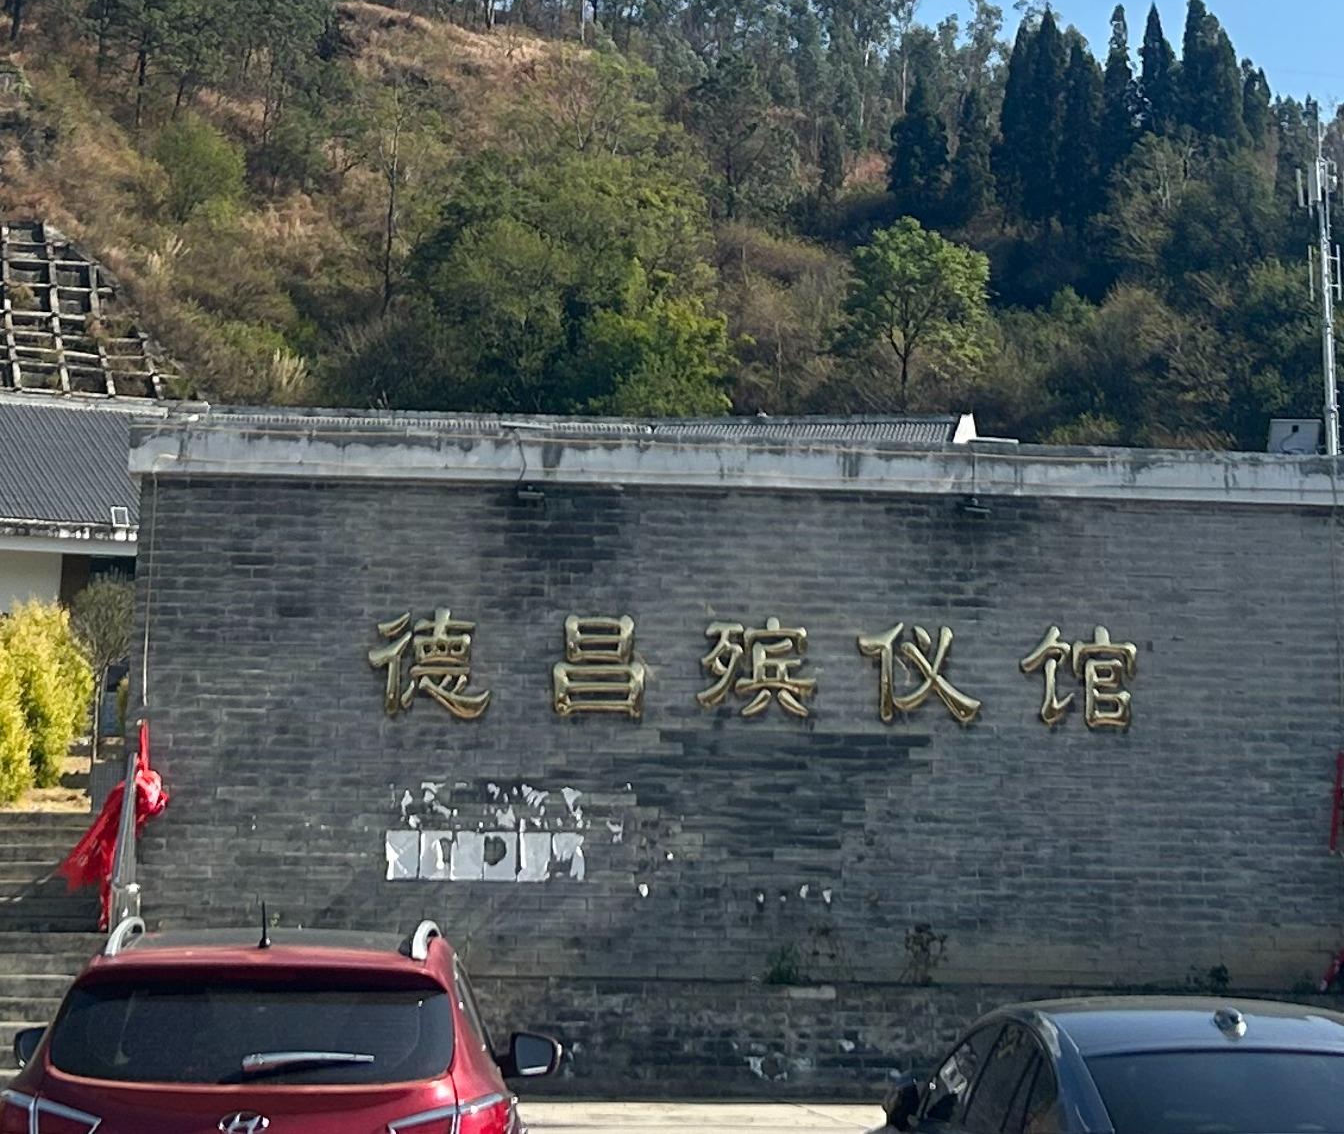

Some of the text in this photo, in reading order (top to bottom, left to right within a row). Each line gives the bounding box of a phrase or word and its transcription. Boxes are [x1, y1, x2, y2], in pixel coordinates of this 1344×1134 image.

[367, 606, 1138, 729] 德昌殡仪馆
